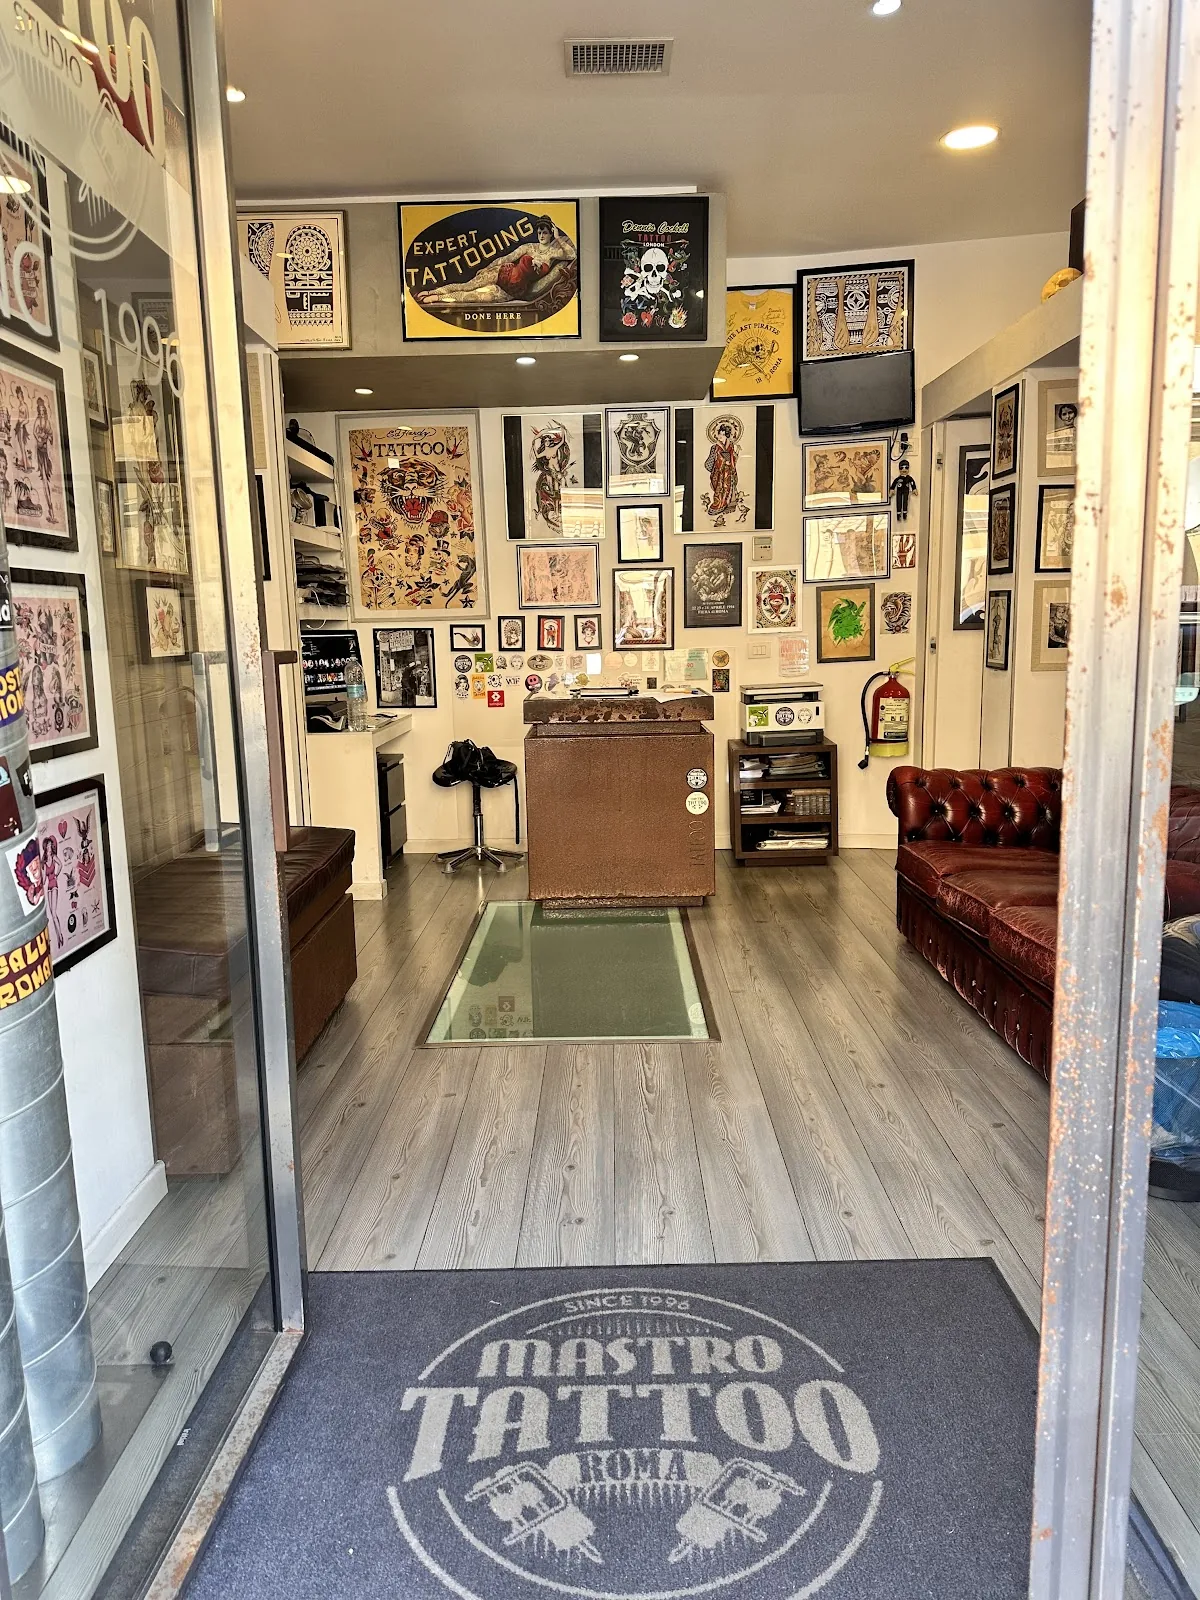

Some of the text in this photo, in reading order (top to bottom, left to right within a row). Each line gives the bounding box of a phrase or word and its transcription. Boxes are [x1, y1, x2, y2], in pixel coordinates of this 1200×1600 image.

[13, 1, 82, 88] STUDIO
[622, 220, 656, 233] Dennis
[413, 230, 478, 255] EXPERT
[638, 234, 672, 242] TATTOO
[406, 216, 534, 287] TATTOOING
[464, 313, 491, 321] DONE
[736, 324, 752, 334] LAST
[754, 322, 781, 336] PIRATES
[94, 288, 185, 398] 1996
[770, 358, 783, 375] ROMA
[373, 441, 445, 457] TATTOO
[564, 1294, 691, 1314] SINCE 1996
[476, 1334, 784, 1379] MASTRO
[400, 1379, 881, 1483] TATTOO
[577, 1449, 690, 1484] ROMA
